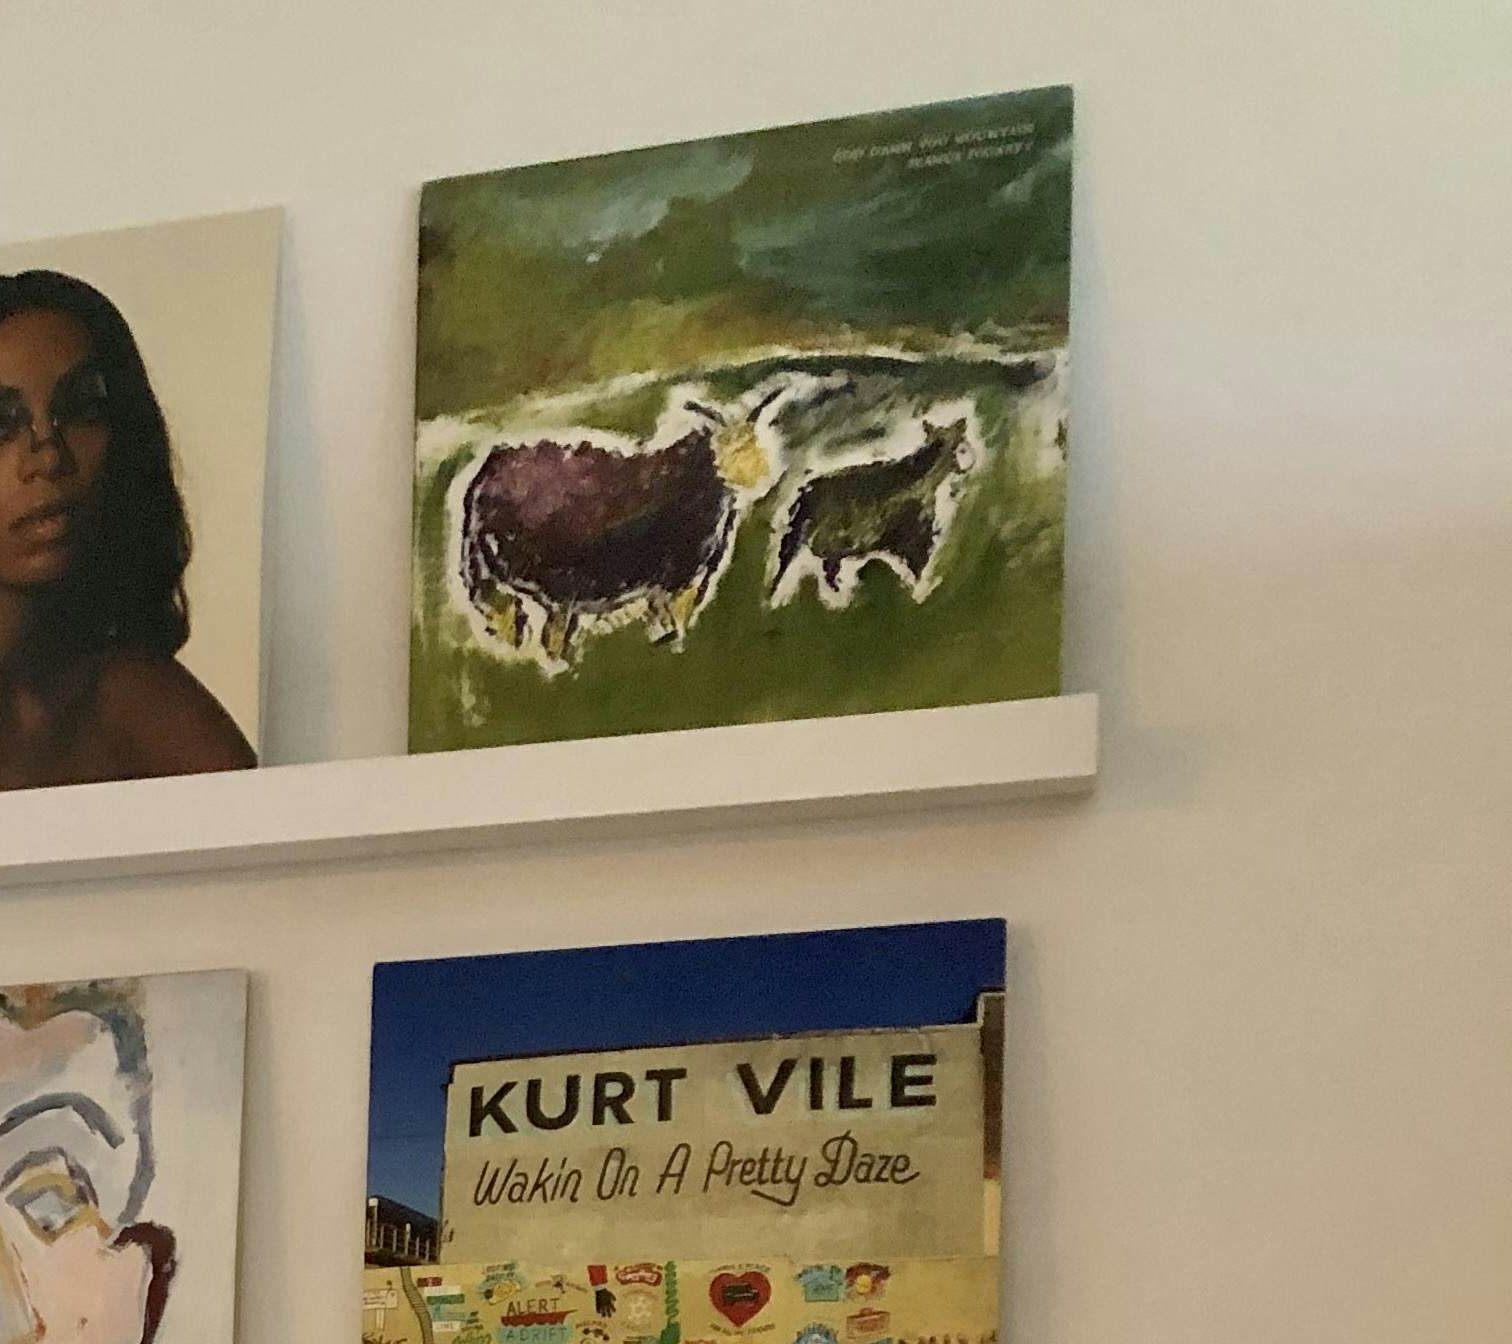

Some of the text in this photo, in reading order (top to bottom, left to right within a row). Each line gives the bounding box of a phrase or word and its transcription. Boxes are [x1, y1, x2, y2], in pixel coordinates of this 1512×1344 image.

[468, 1053, 938, 1137] KURT VILE
[473, 1129, 920, 1207] Wakin On A Pretty Daze
[506, 1298, 561, 1317] ALERT
[505, 1327, 568, 1343] ADRIFT
